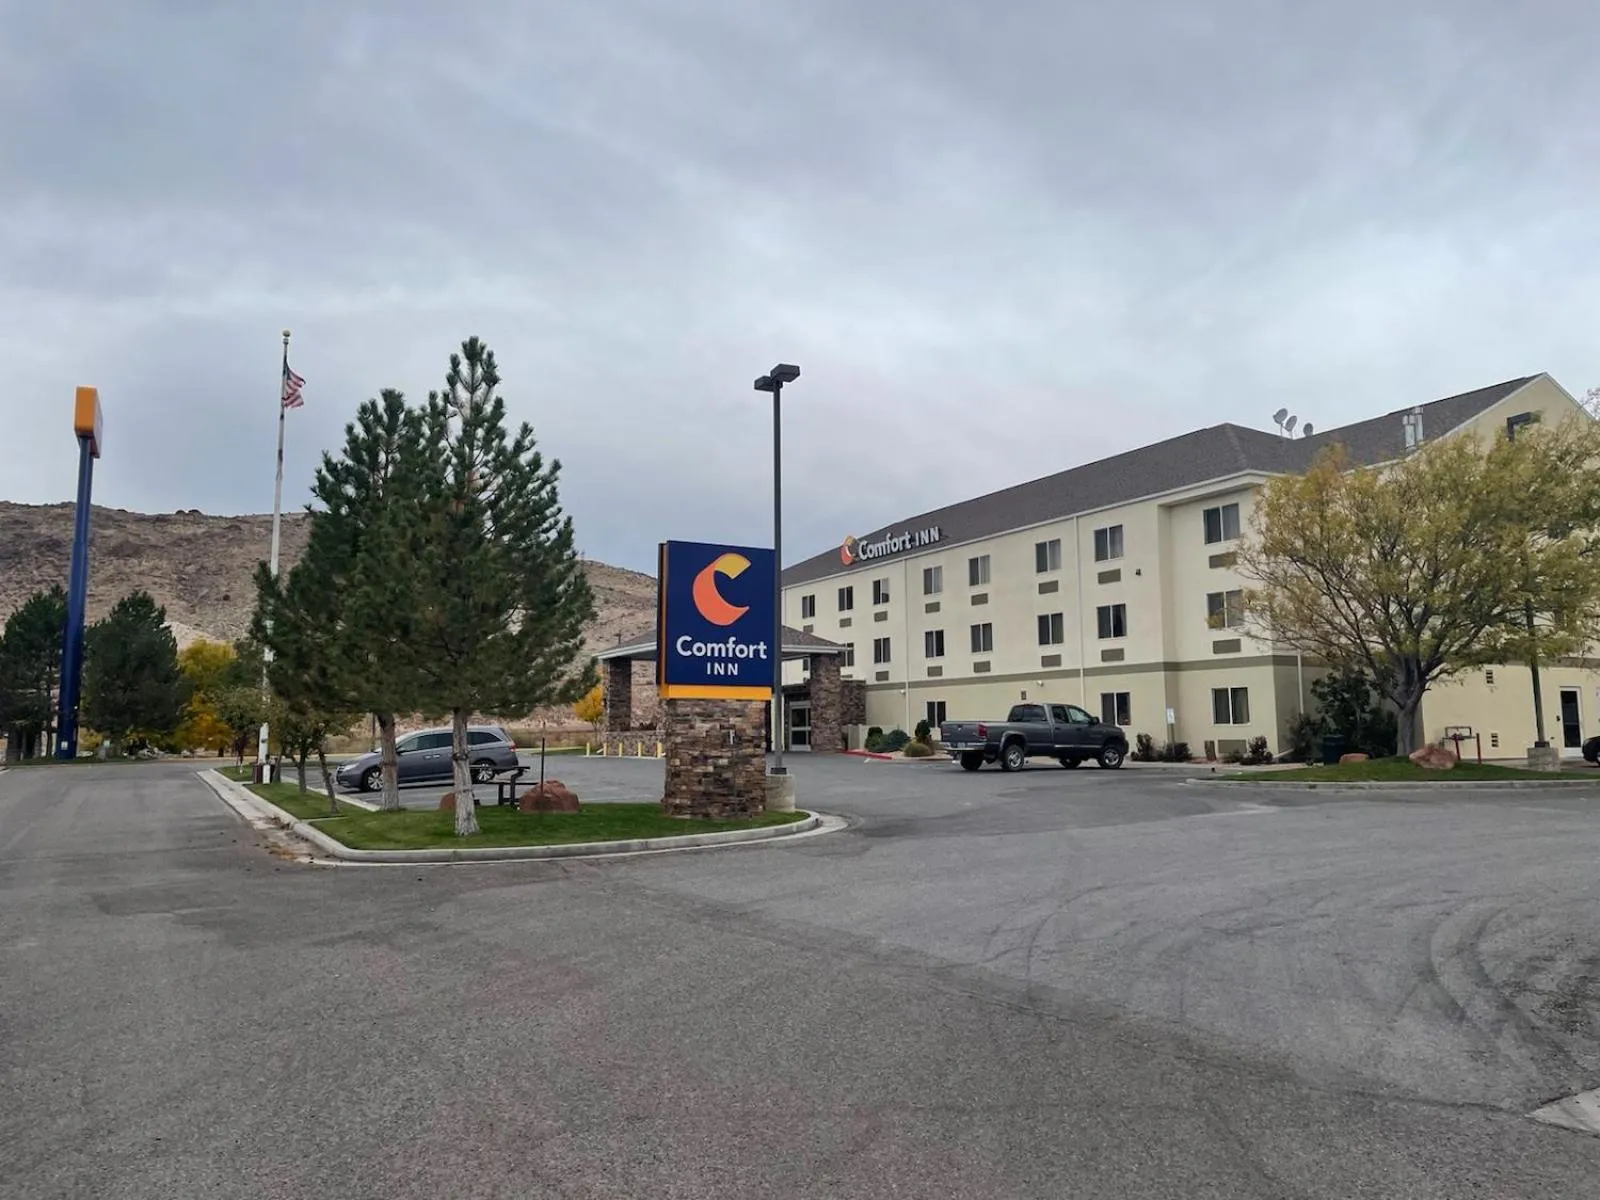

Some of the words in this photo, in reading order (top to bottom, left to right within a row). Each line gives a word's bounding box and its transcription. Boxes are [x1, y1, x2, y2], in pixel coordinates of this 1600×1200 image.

[859, 530, 912, 560] Comfort
[915, 526, 940, 547] INN
[676, 635, 767, 660] Comfort
[706, 662, 739, 676] INN
